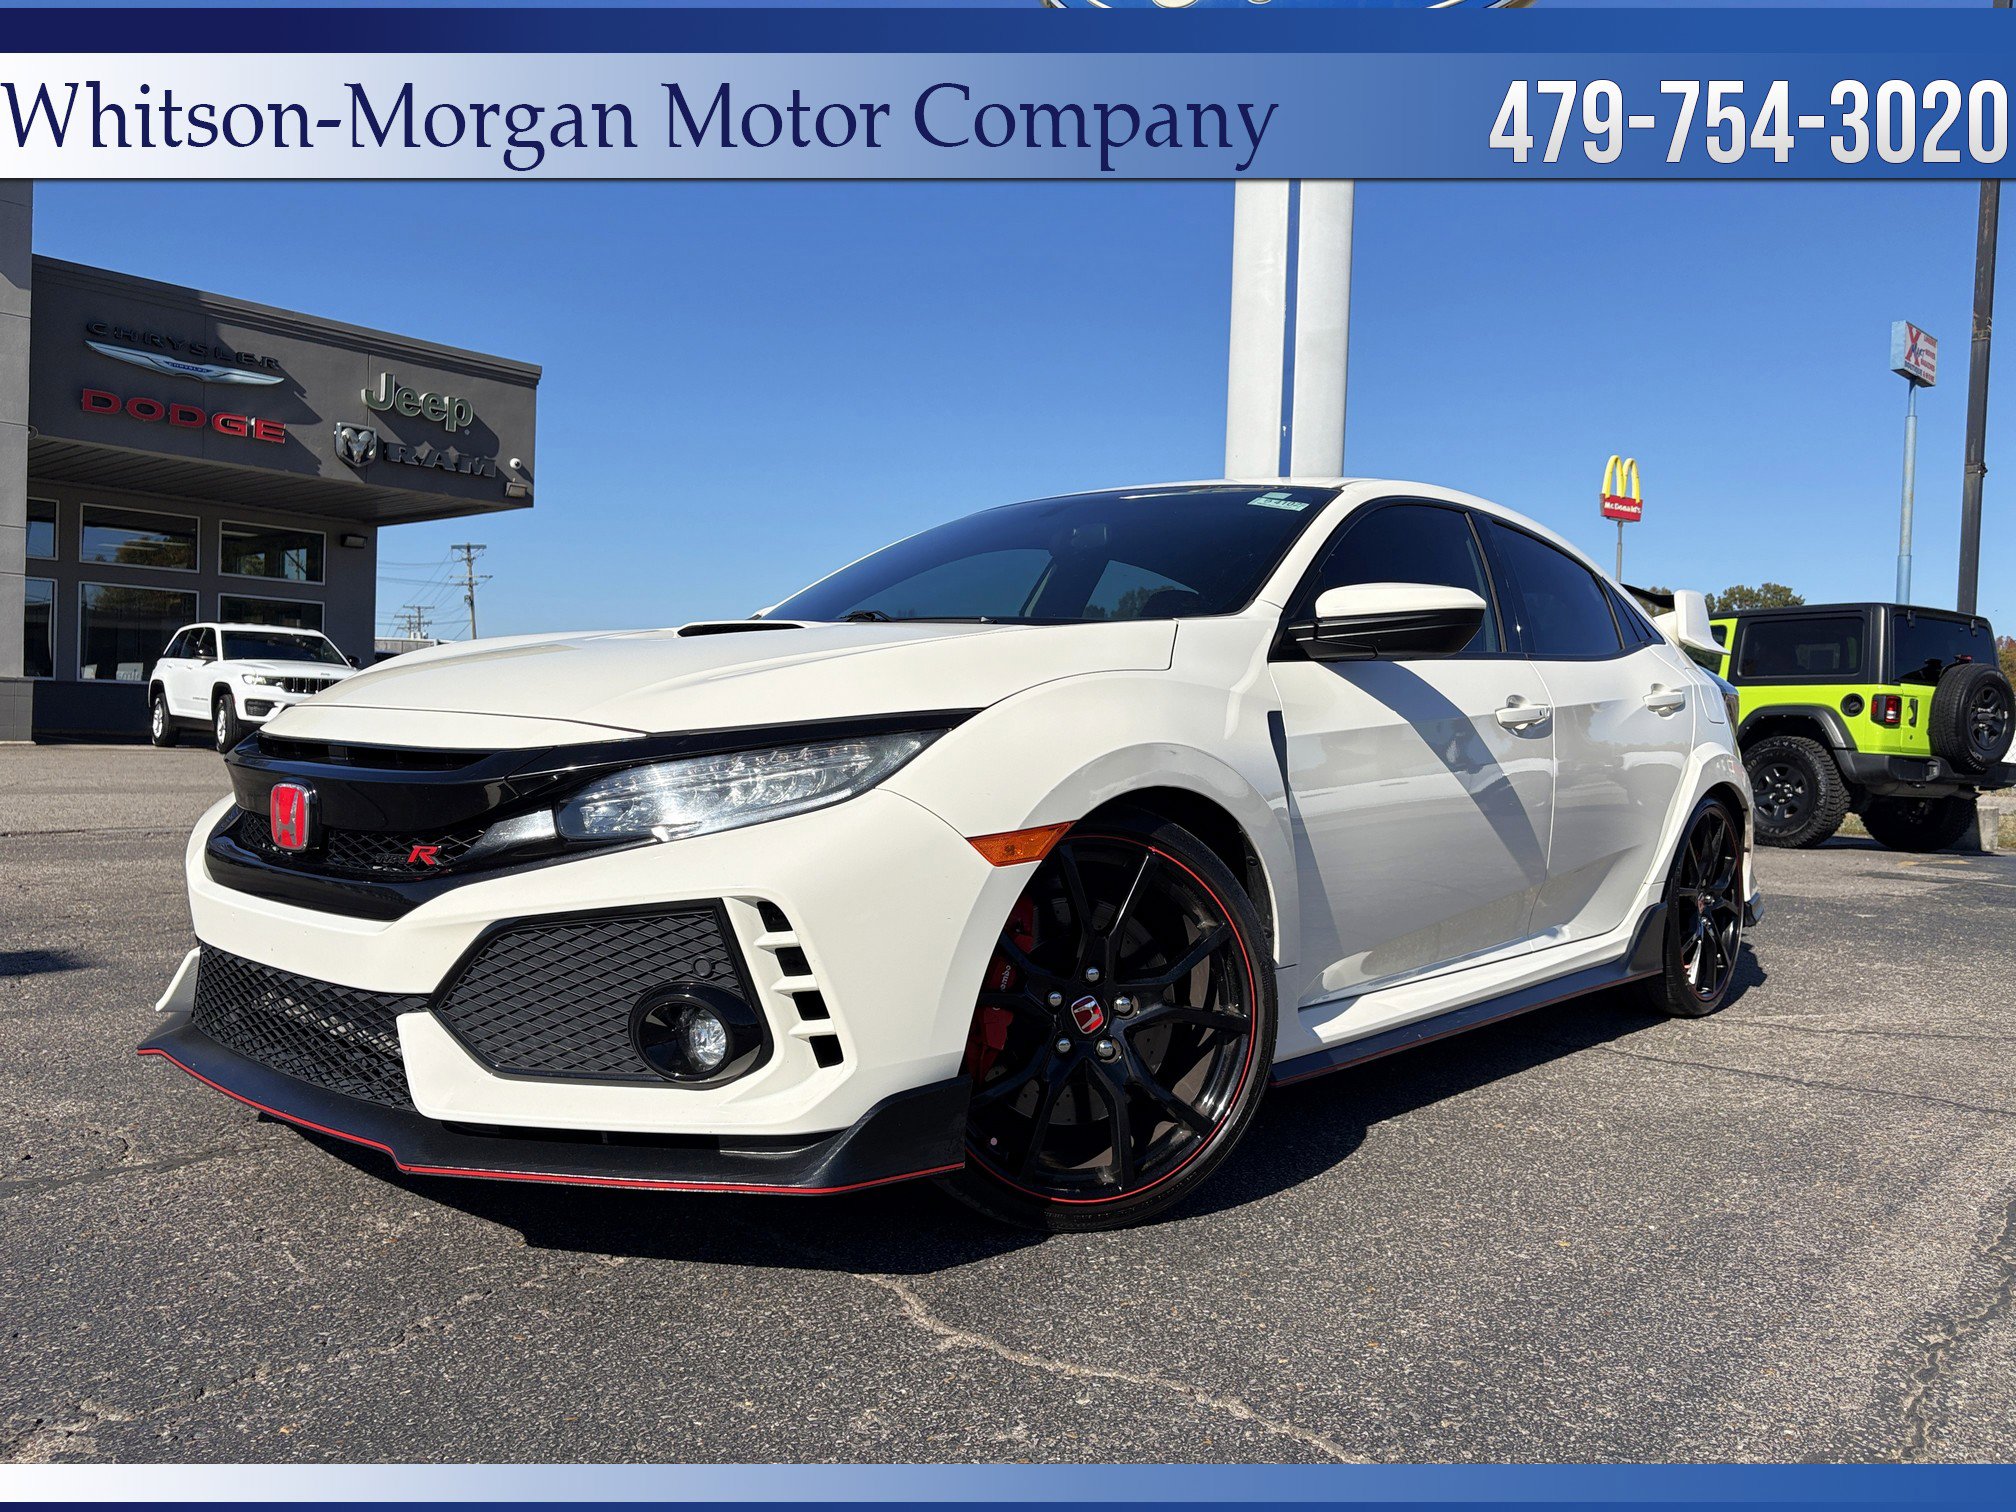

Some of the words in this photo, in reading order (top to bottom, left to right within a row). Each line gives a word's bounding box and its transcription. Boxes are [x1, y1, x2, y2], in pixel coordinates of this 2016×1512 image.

[86, 321, 280, 370] CHRYSLER
[82, 388, 286, 444] DODGE
[361, 372, 474, 432] Jeep
[384, 442, 497, 478] RAM
[1604, 501, 1641, 514] McDonald's
[407, 845, 442, 867] R
